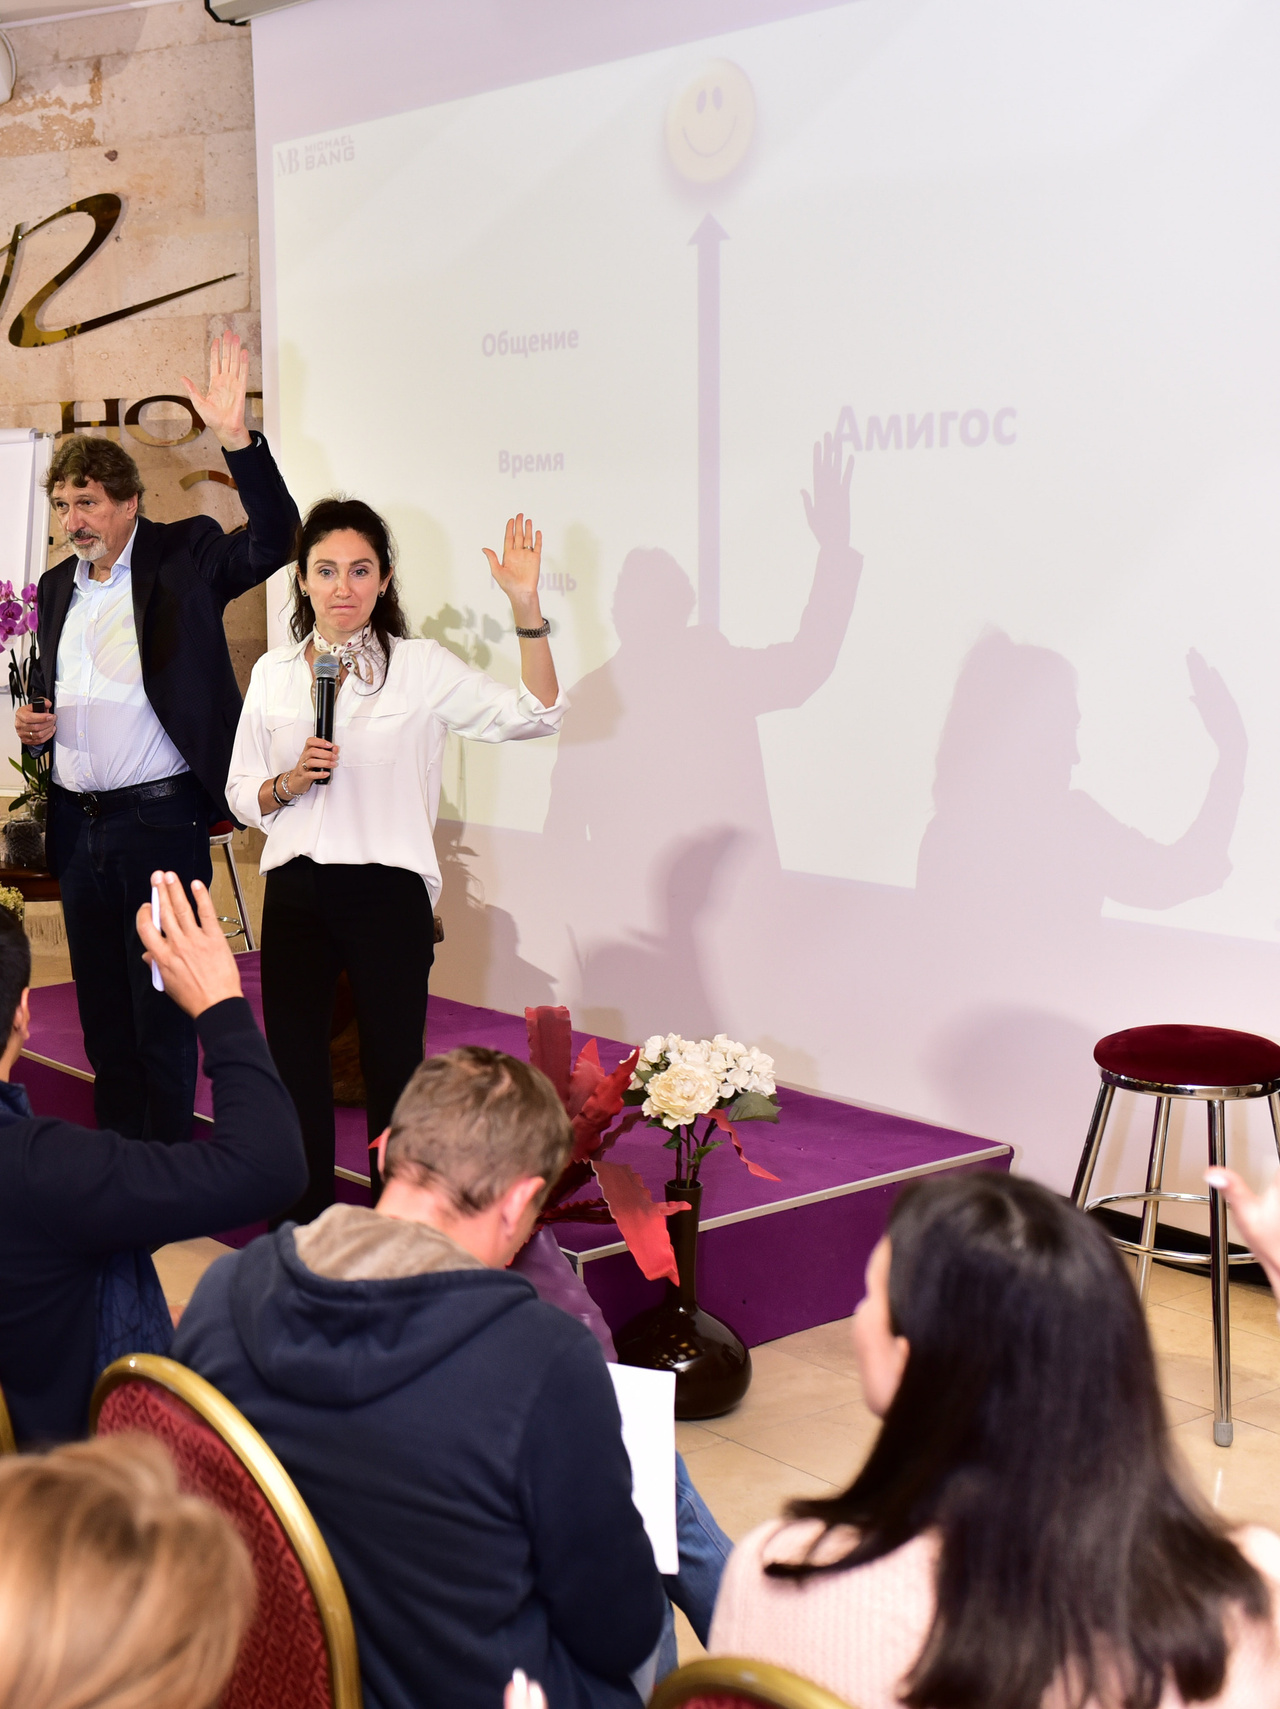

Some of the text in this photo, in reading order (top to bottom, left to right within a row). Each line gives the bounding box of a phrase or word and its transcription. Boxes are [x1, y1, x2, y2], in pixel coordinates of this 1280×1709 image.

[304, 145, 356, 171] BANG
[481, 329, 580, 358] Общение
[834, 404, 1018, 453] Амигос
[498, 449, 565, 479] Время
